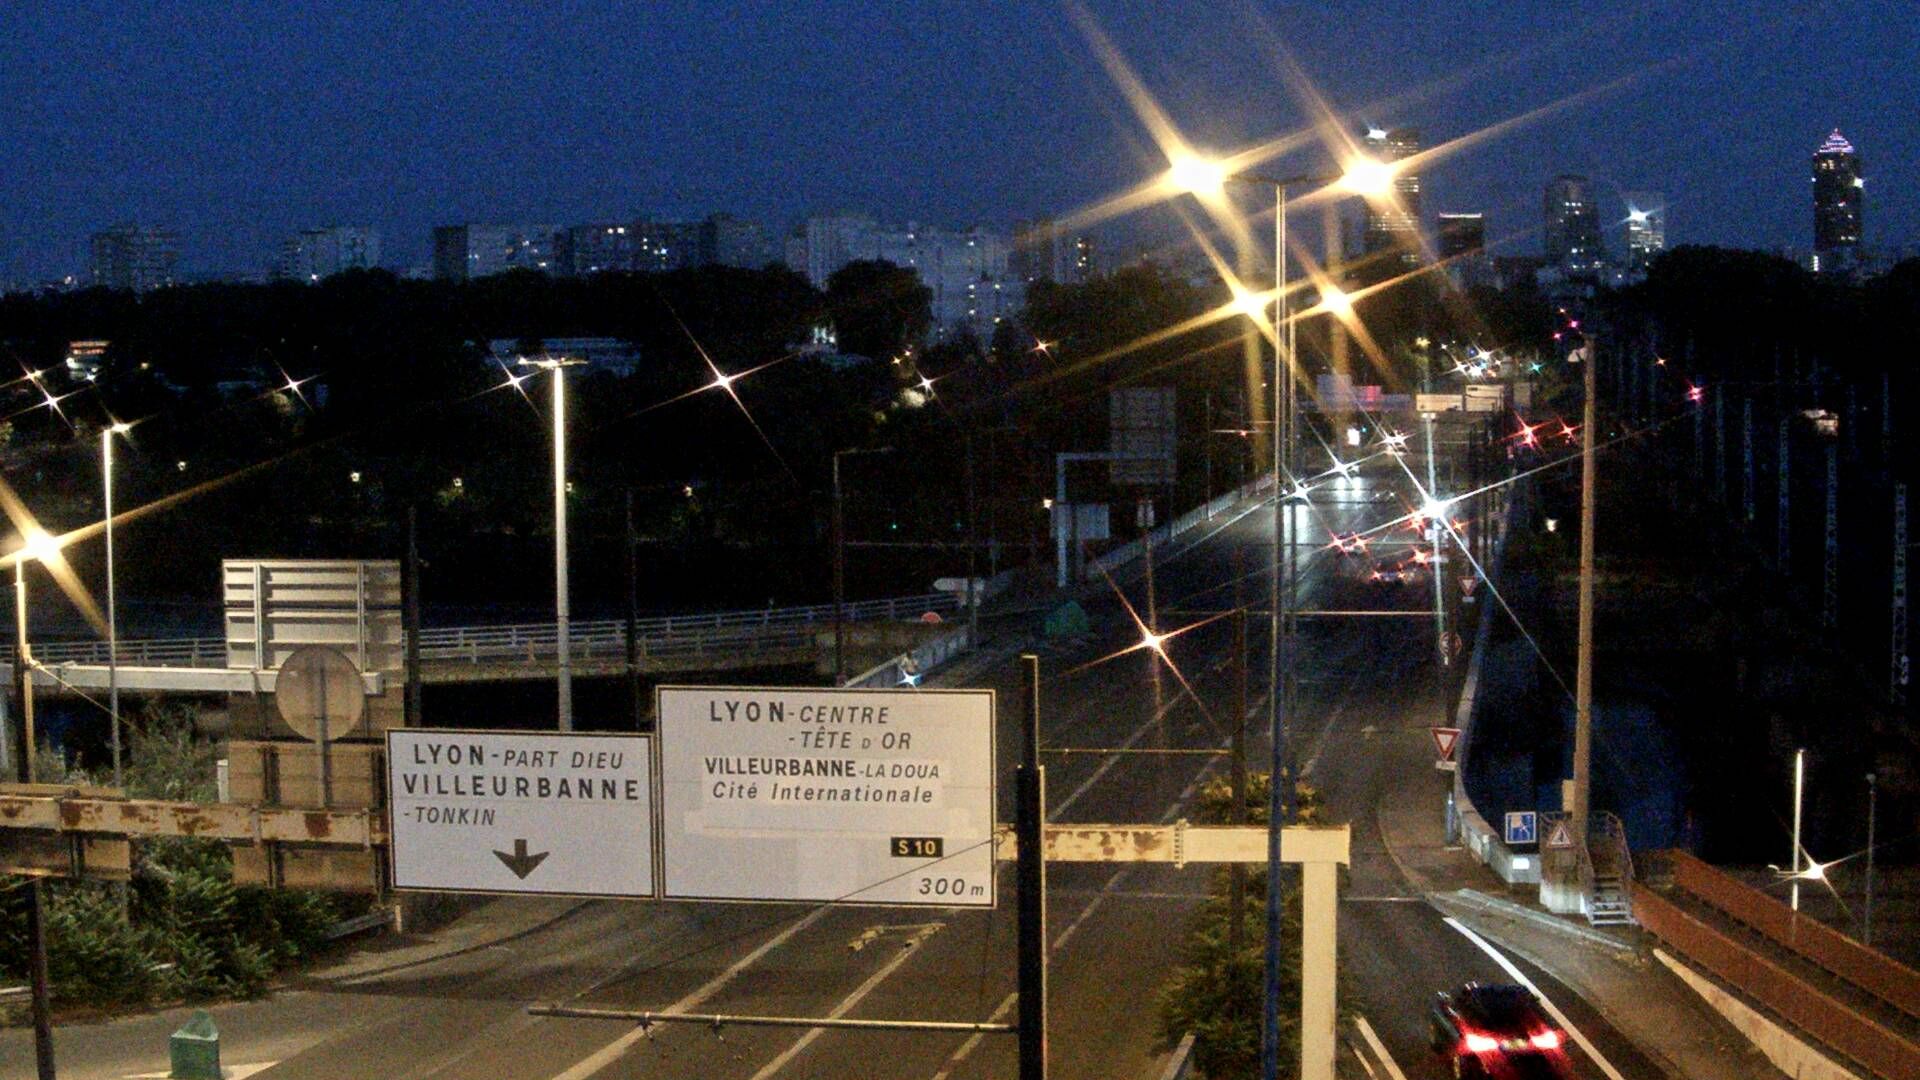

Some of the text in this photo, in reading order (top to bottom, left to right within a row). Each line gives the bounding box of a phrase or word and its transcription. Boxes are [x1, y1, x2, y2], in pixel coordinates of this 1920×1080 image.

[881, 731, 912, 750] OR
[570, 751, 624, 770] DIEU
[890, 763, 940, 779] DOUA
[402, 773, 640, 801] VILLEURBANNE
[712, 781, 933, 803] Cité Internationale
[918, 877, 985, 896] 300 m
